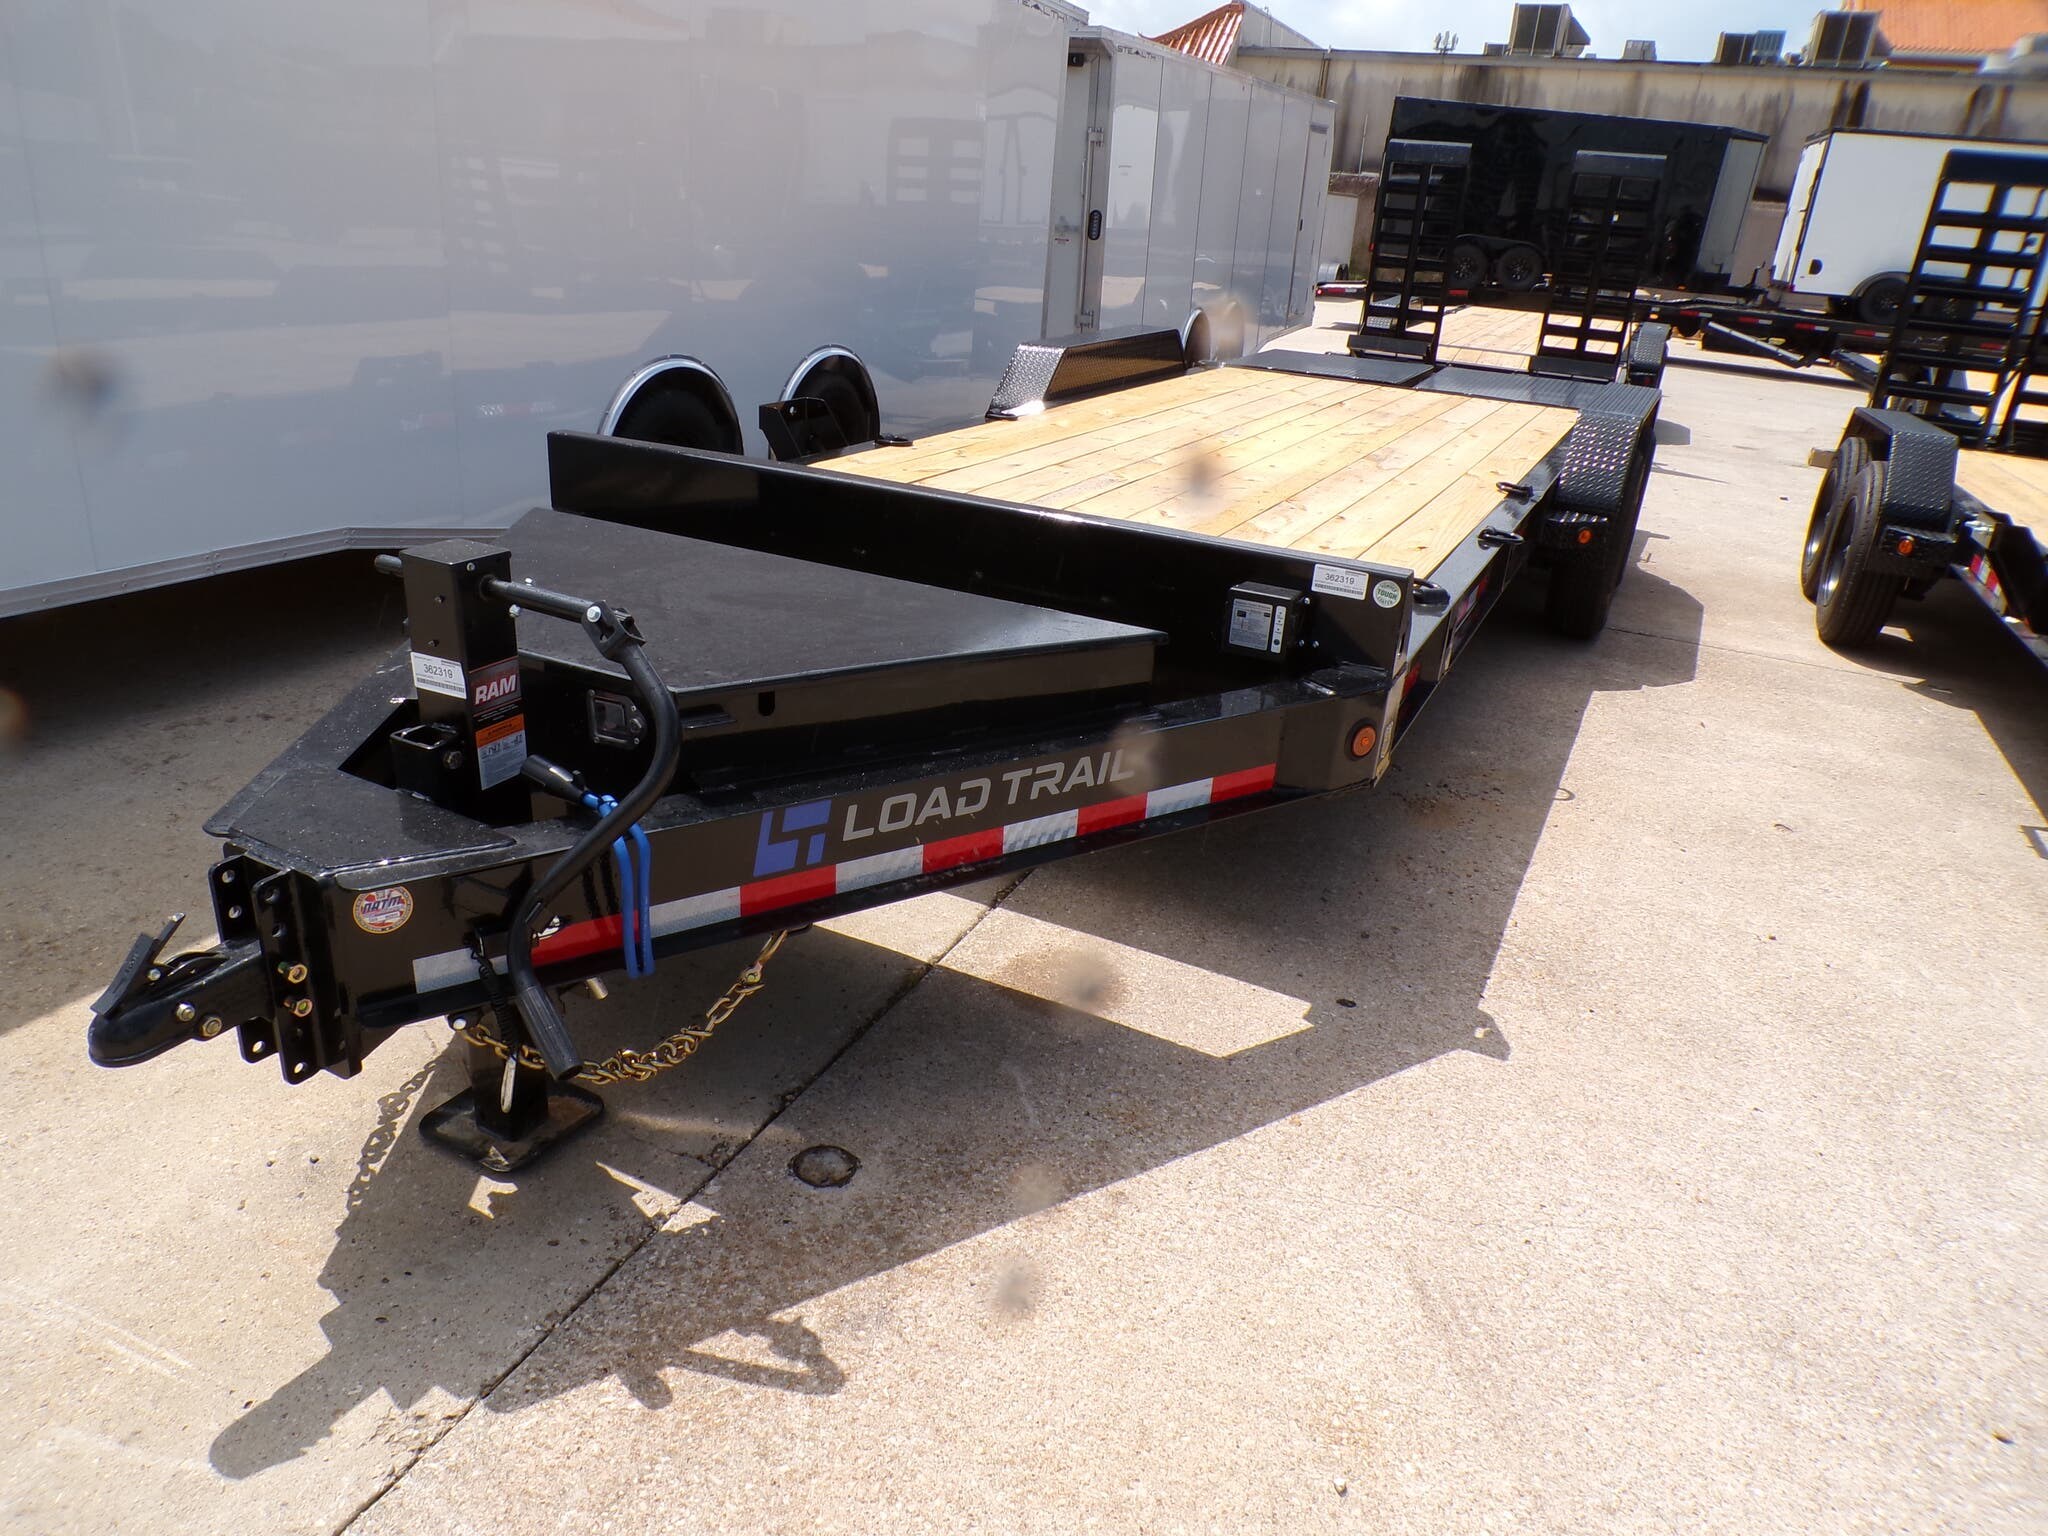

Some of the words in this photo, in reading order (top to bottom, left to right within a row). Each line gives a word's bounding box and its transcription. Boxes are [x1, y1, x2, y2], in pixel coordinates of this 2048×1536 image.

[1117, 45, 1156, 60] STEALTH
[1325, 572, 1355, 585] 362319
[475, 674, 516, 705] RAM
[842, 777, 991, 842] LOAD
[1002, 749, 1135, 805] TRAIL
